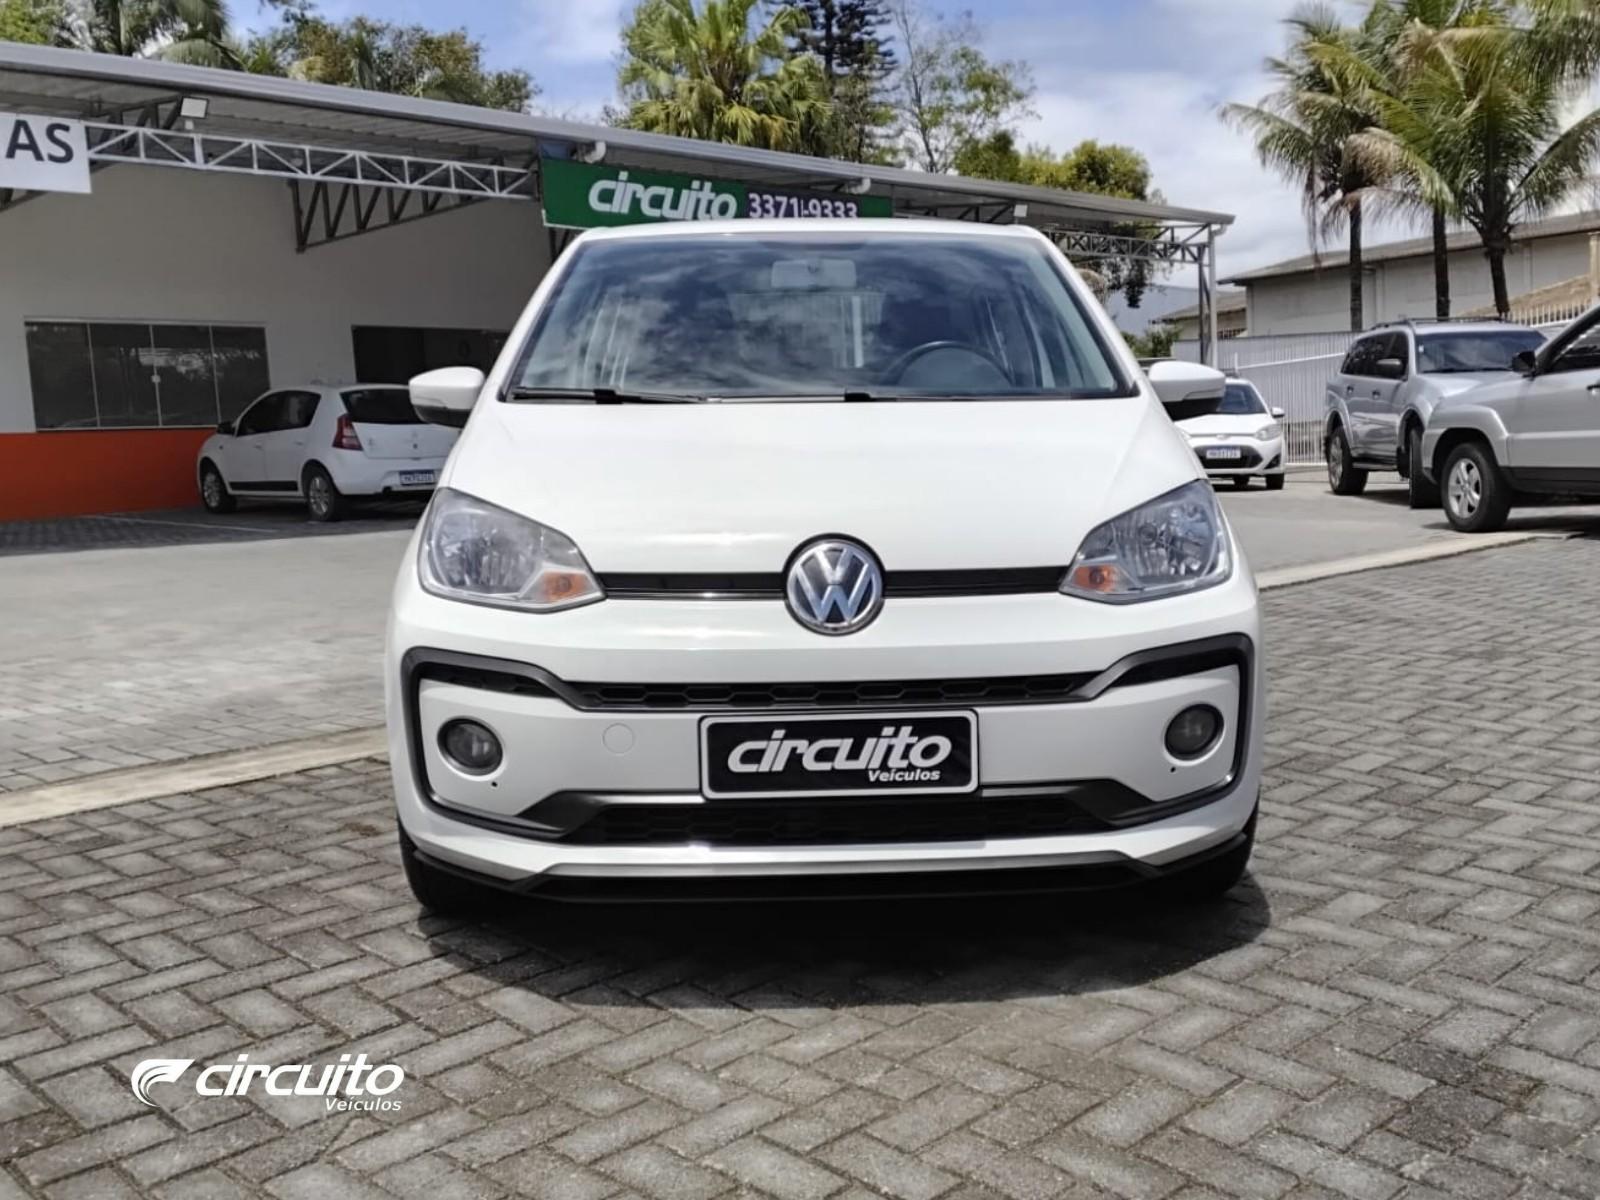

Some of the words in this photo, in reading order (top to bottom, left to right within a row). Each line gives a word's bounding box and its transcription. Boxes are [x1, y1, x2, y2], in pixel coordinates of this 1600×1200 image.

[5, 119, 74, 164] AS
[588, 171, 738, 220] circuito
[748, 192, 858, 218] 3371-9333
[795, 547, 871, 623] VW
[727, 726, 952, 773] circuito
[868, 768, 941, 783] Veículos
